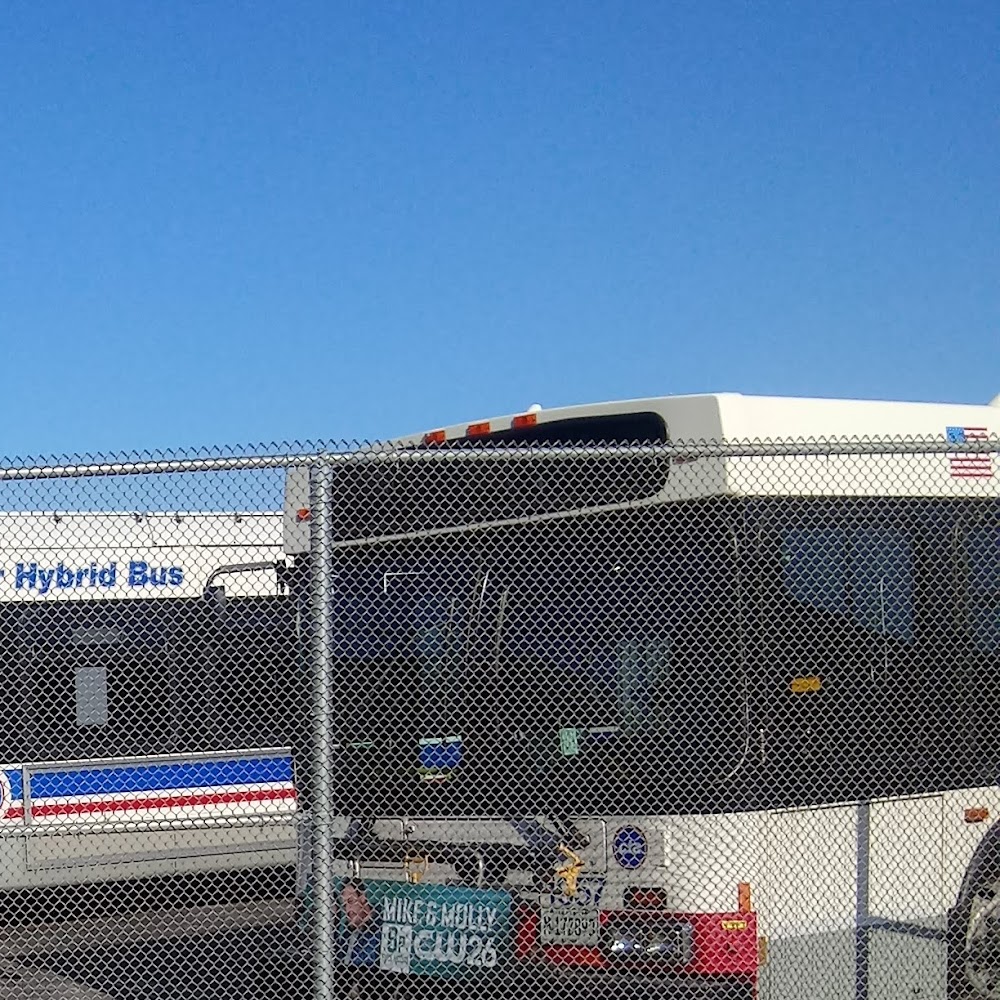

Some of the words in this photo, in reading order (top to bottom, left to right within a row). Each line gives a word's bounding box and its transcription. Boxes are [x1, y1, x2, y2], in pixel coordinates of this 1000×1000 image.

[15, 561, 118, 594] Hybrid
[128, 560, 184, 587] Bus
[383, 897, 424, 924] MIKE
[441, 902, 499, 933] MOLLY
